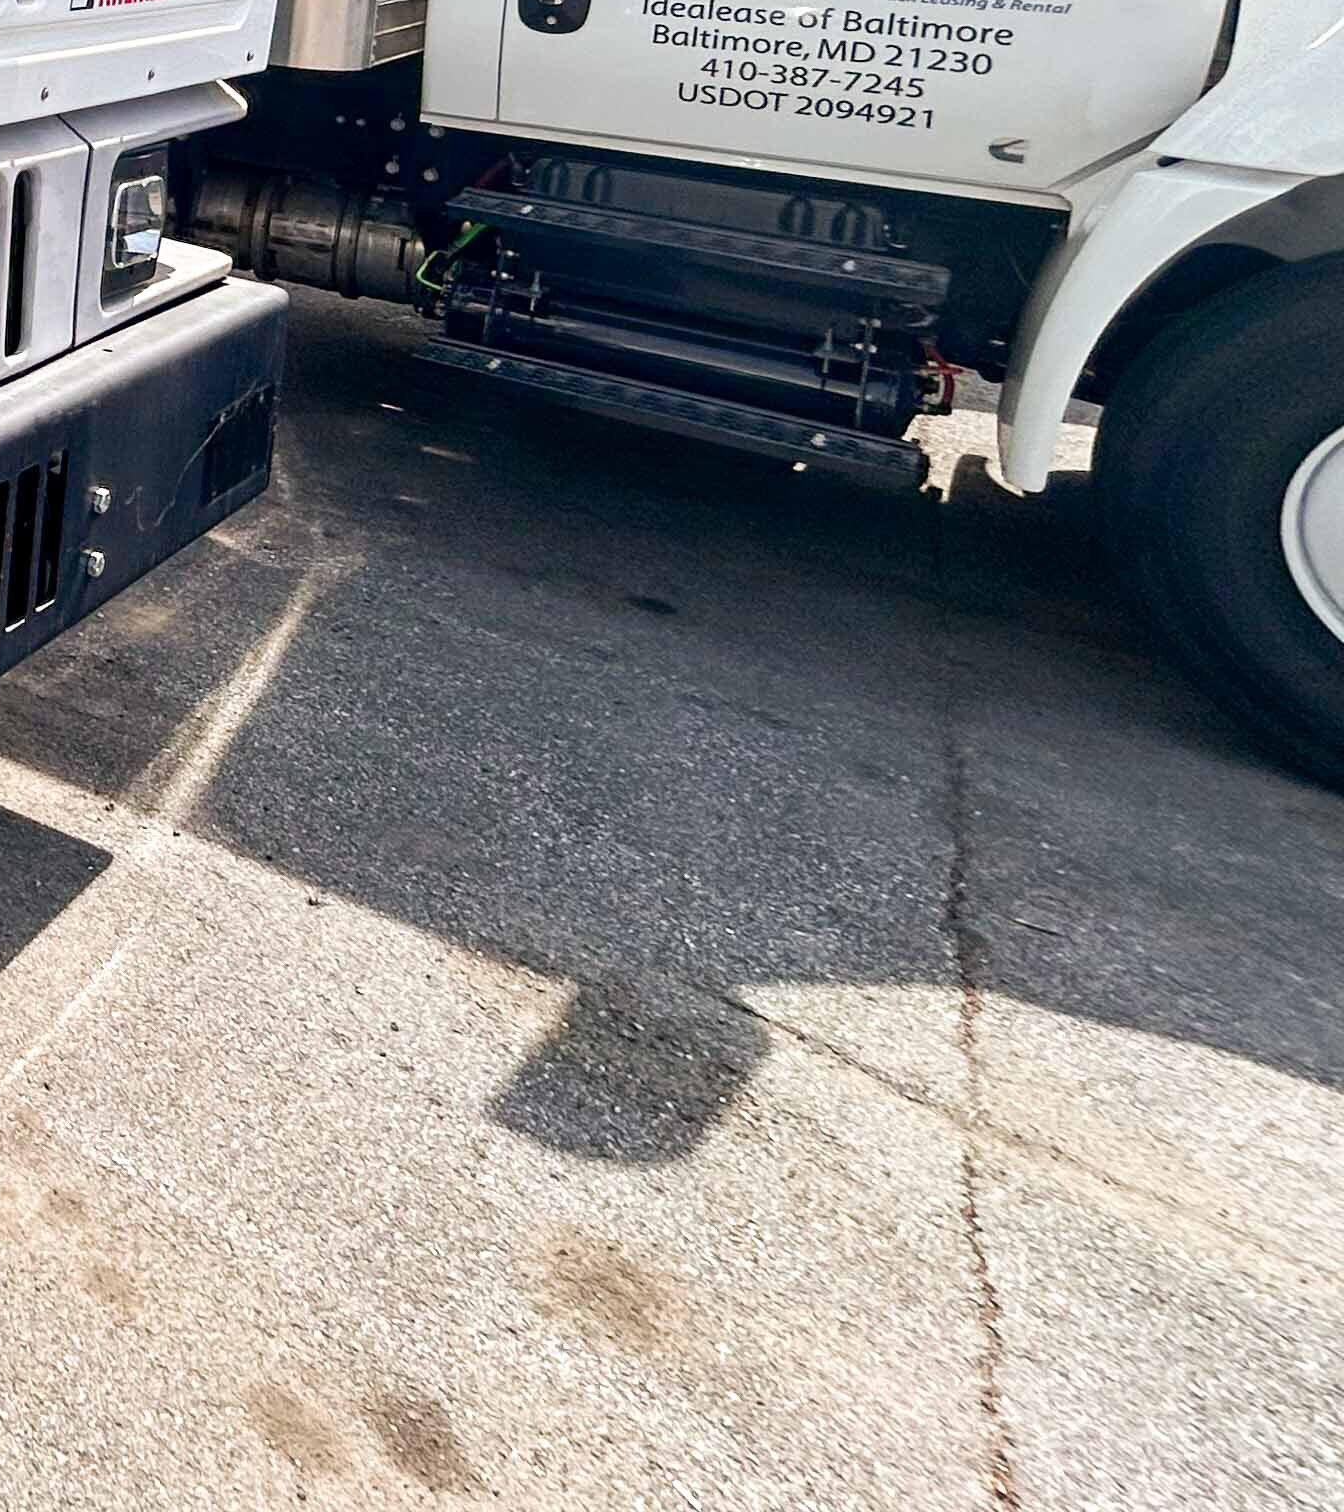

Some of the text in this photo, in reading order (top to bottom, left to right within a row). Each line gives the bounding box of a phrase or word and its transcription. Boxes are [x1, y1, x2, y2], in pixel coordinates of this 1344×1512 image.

[798, 7, 836, 29] of
[843, 10, 1014, 46] Baltimore
[1009, 0, 1072, 14] Rental
[652, 24, 993, 75] Baltimore, MD 21230
[700, 58, 926, 98] 410-387-7245
[678, 82, 934, 129] USDOT 2094921
